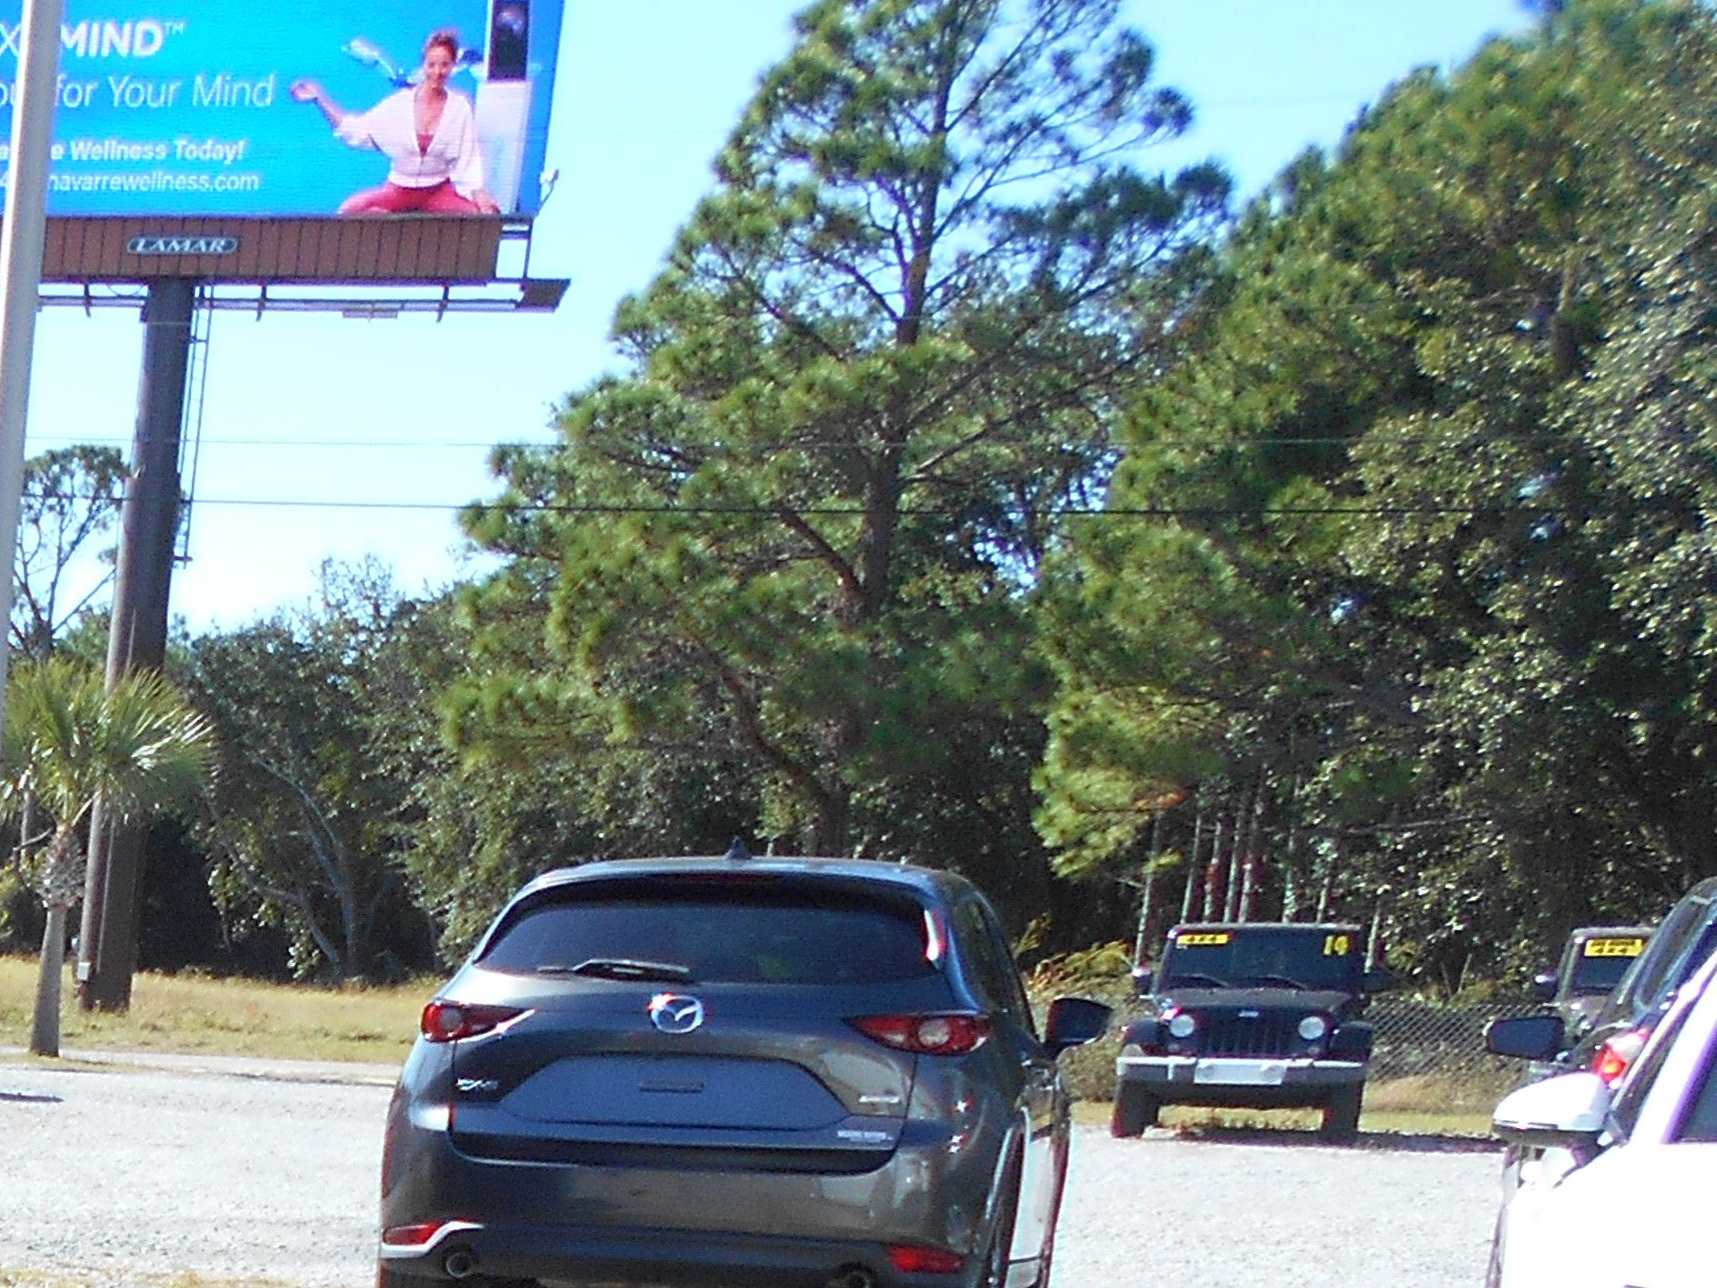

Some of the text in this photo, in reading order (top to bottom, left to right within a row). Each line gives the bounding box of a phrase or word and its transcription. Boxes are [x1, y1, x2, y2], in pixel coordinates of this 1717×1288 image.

[108, 74, 181, 108] Your
[192, 73, 276, 108] Mind
[70, 140, 166, 161] Wellness
[173, 139, 246, 164] Today!
[134, 237, 227, 253] LAMAR
